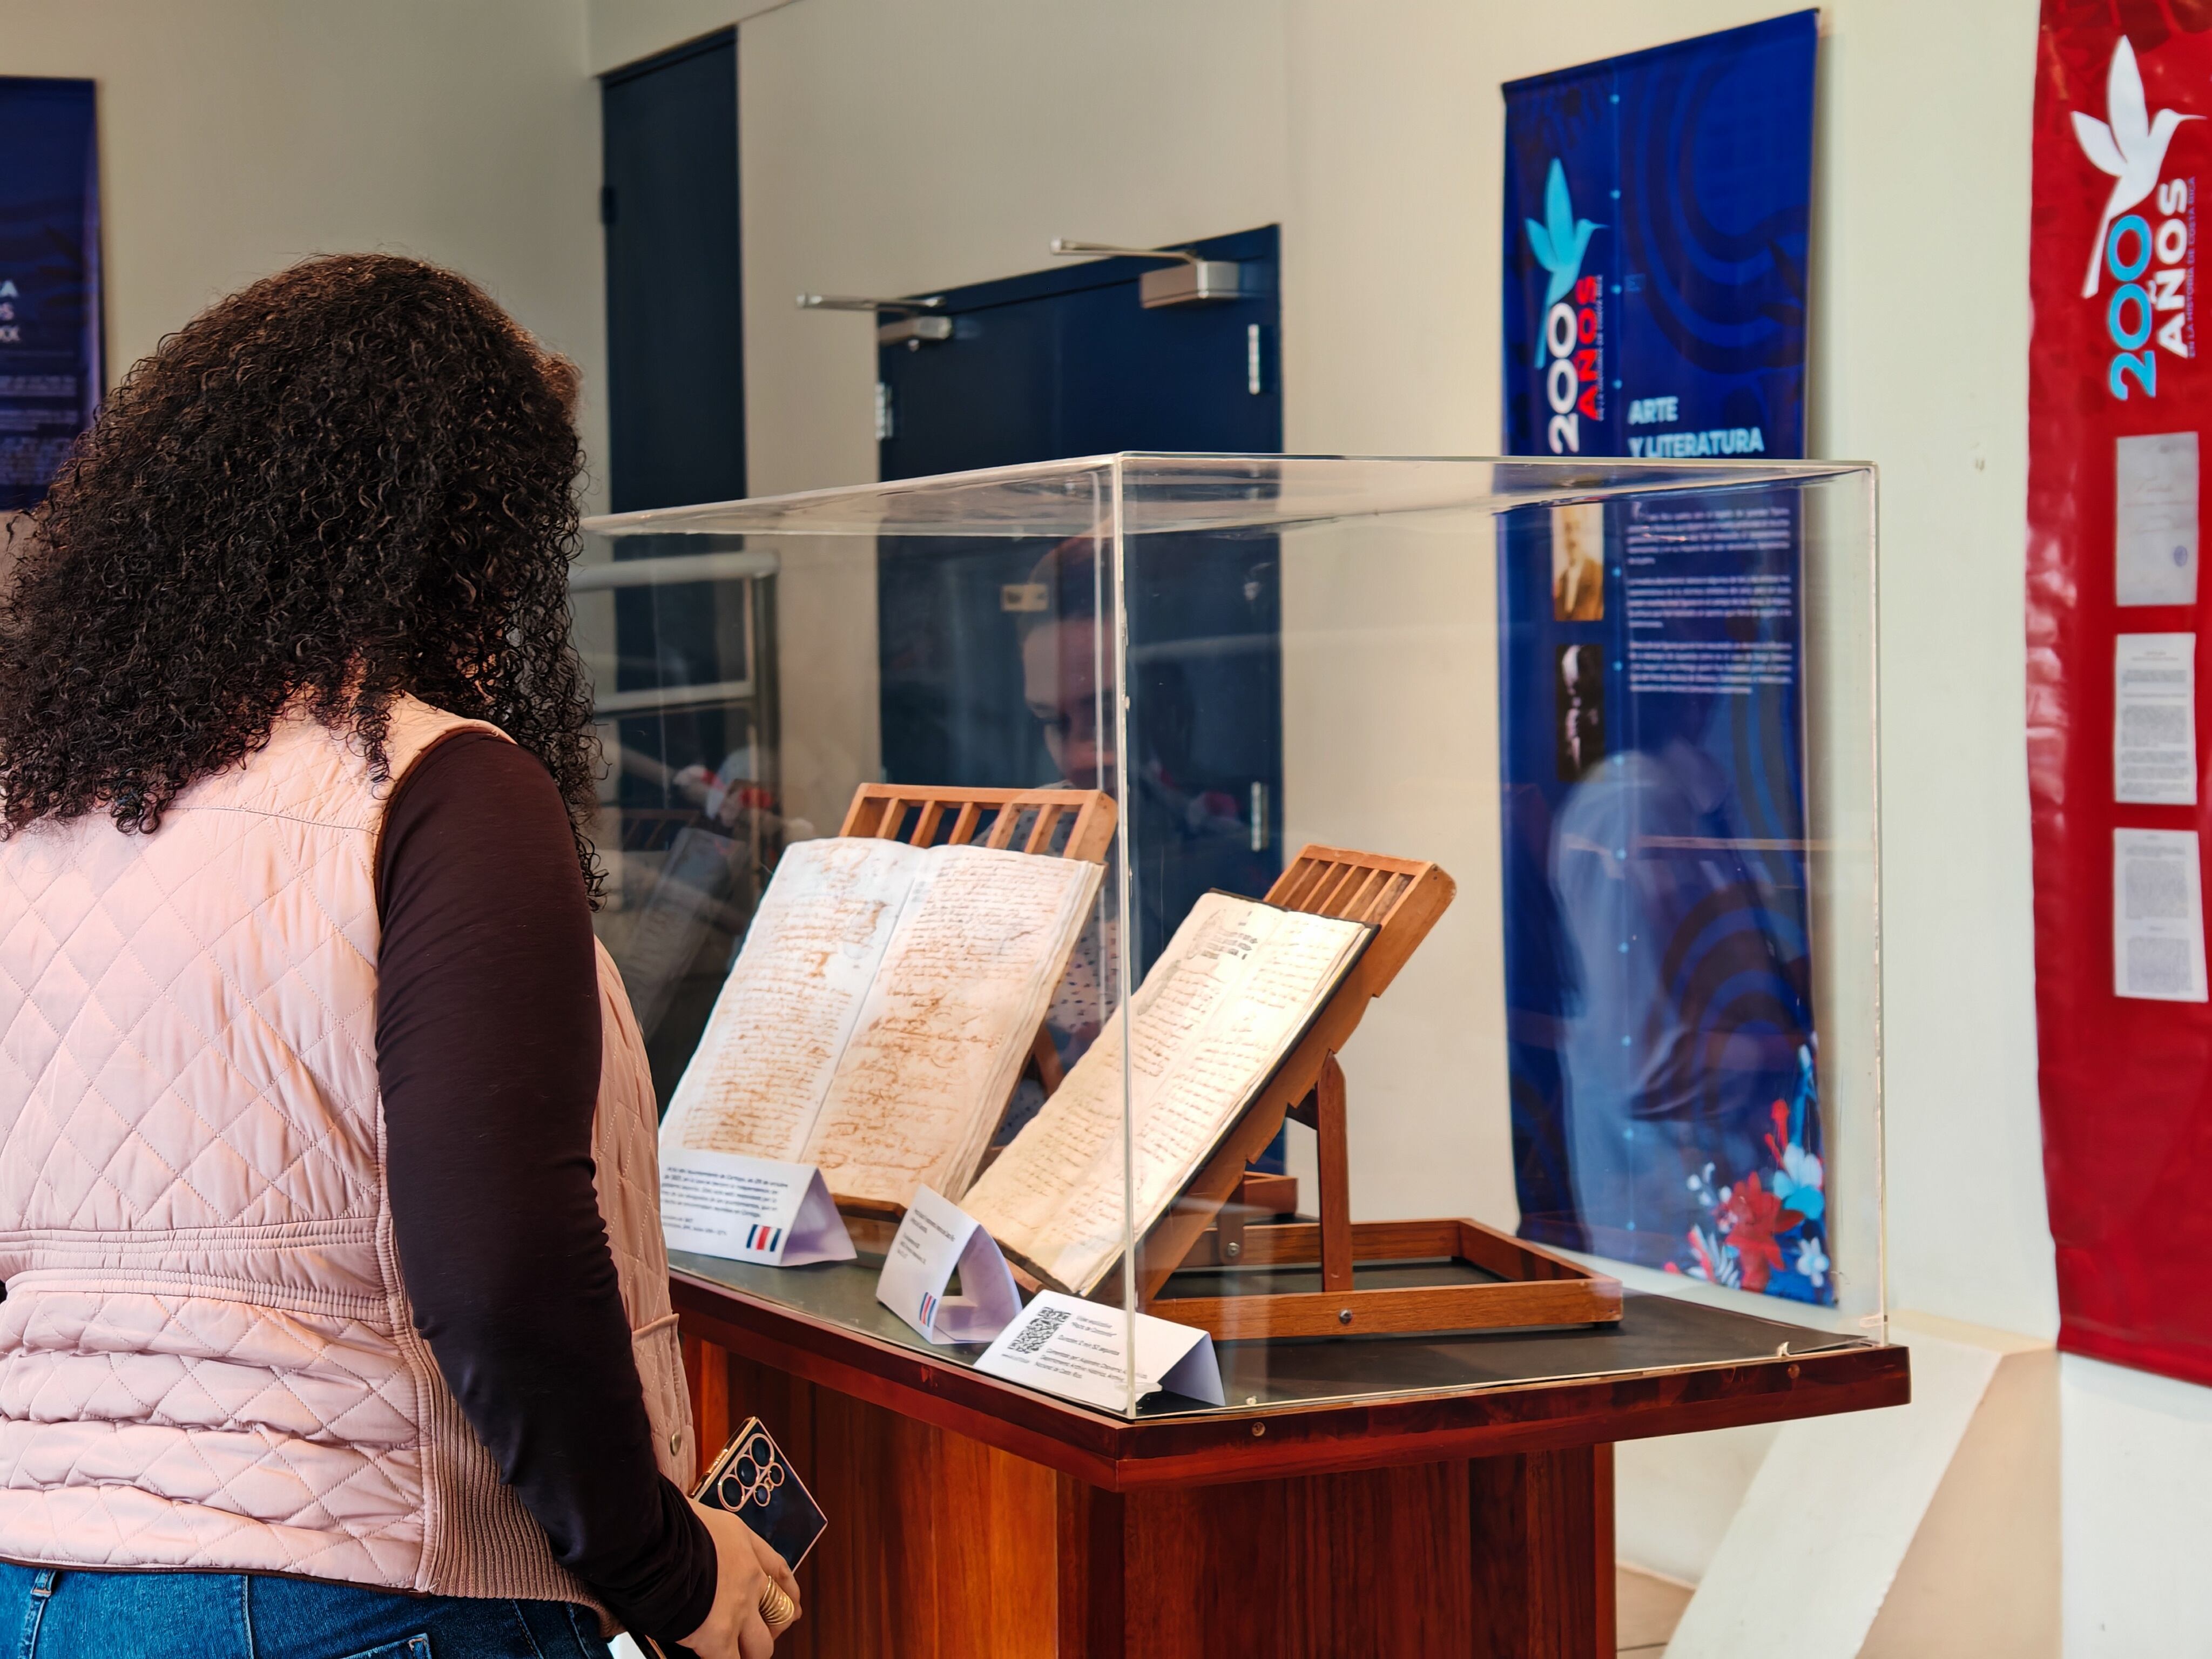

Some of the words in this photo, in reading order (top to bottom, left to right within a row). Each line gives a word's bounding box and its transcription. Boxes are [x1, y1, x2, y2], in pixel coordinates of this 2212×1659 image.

[2107, 214, 2157, 402] 200
[2147, 178, 2188, 358] AÑOS
[1547, 302, 1580, 454] 200
[1572, 275, 1599, 421] AÑOS
[1628, 396, 1678, 425] ARTE
[1628, 436, 1643, 457] Y
[1645, 427, 1765, 458] LITERATURA
